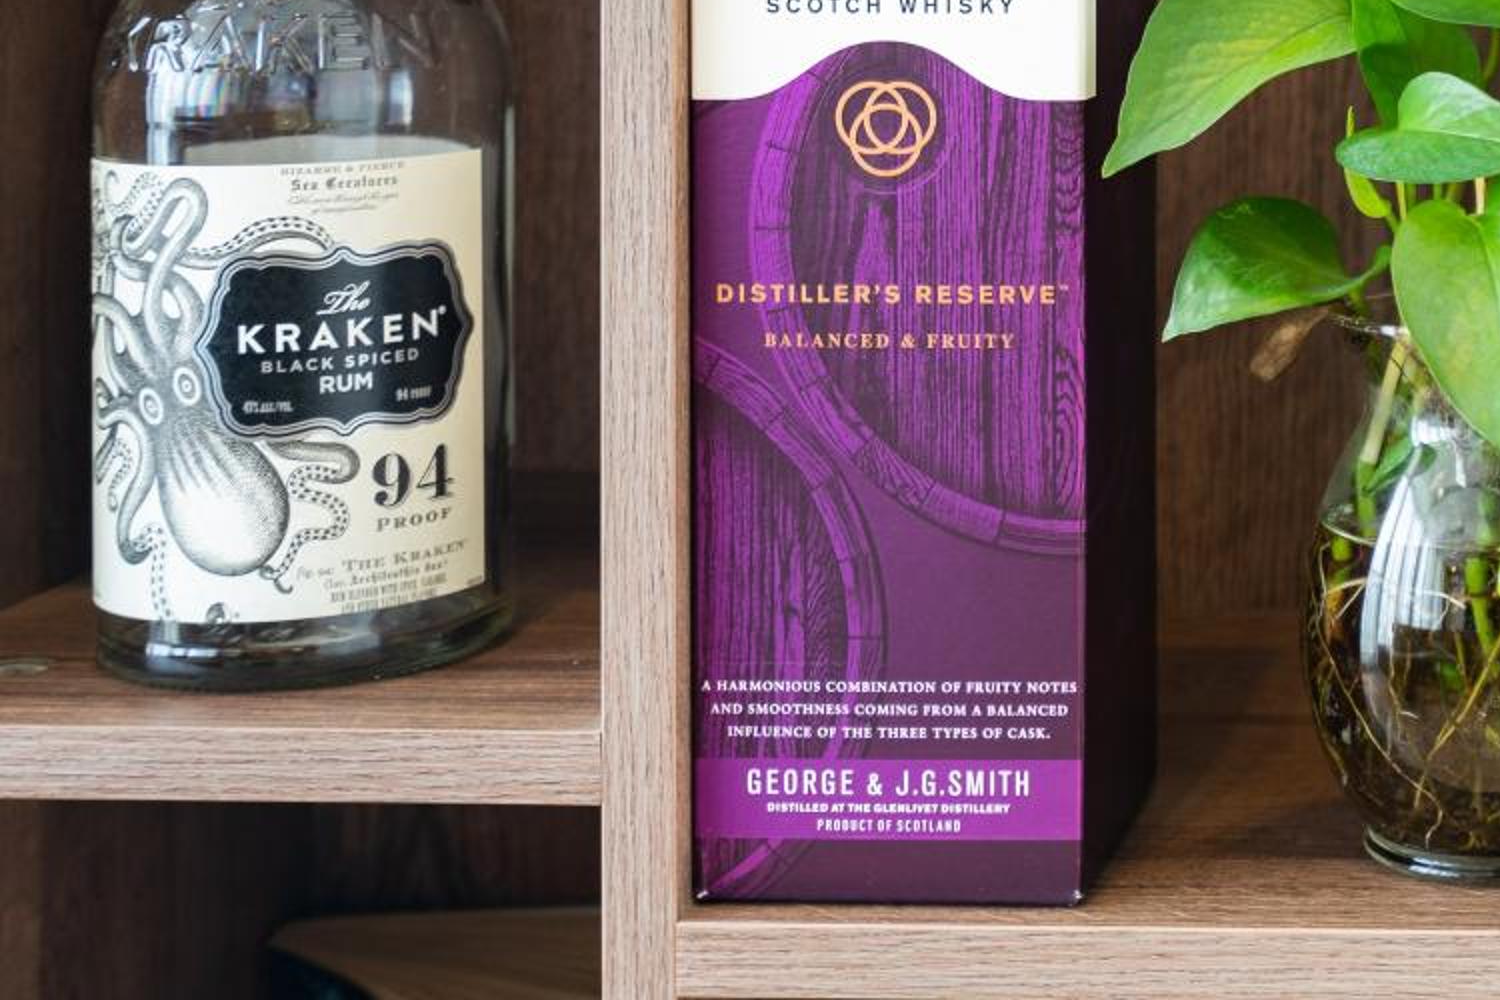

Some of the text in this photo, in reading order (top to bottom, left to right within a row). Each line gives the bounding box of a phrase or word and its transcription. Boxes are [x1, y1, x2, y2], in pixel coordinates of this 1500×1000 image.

[291, 179, 319, 191] Sea
[316, 280, 371, 315] The
[716, 283, 1057, 305] DISTILLER'S RESERVE
[237, 306, 439, 354] KRAKEN
[764, 333, 1016, 349] BALANCED & FRUITY
[261, 348, 419, 374] BLACK SPICED
[319, 371, 373, 395] RUM
[372, 443, 456, 509] 94
[377, 507, 452, 532] PROOF
[702, 680, 1077, 694] A HARMONIOUS COMBINATION OF FRUITY NOTES
[710, 703, 1069, 717] AND SMOOTHNESS COMING FROM A BALANCED
[727, 725, 1051, 739] INFLUENCE OF THE THREE TYPES OF CASK.
[747, 768, 1030, 797] GEORGE & J.G.SMITH
[767, 802, 1011, 813] DISTILLED AT THE GLENLIVET DISTILLERY
[816, 819, 961, 833] PRODUCT OF SCOTLAND
